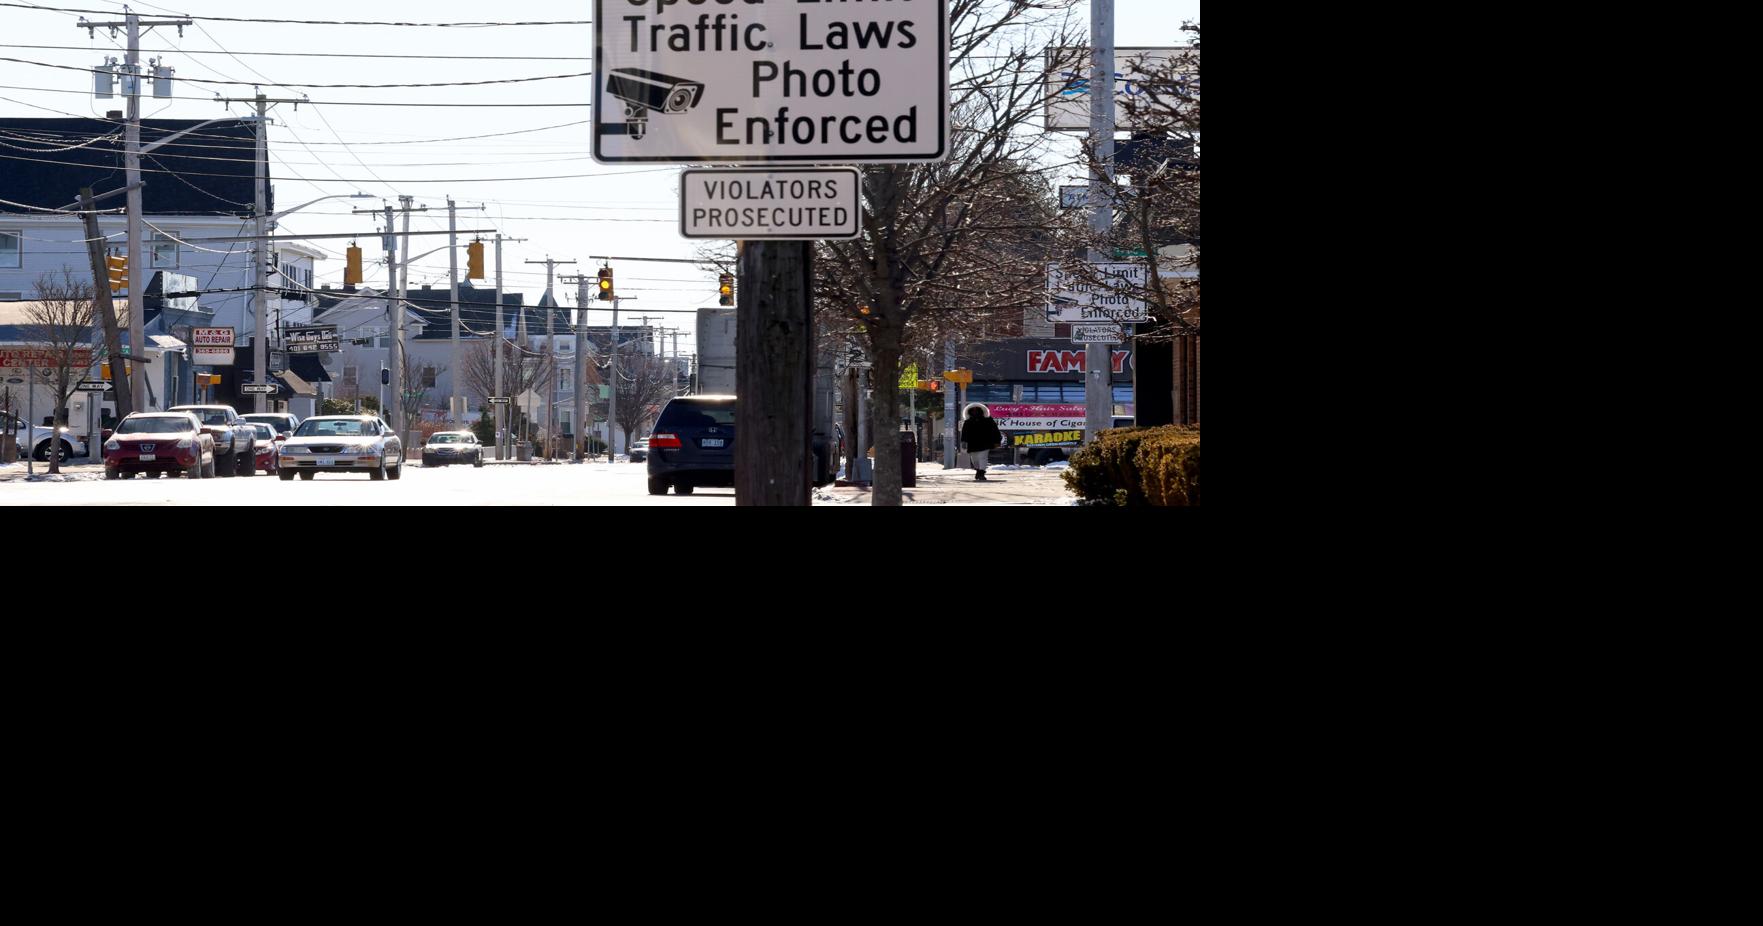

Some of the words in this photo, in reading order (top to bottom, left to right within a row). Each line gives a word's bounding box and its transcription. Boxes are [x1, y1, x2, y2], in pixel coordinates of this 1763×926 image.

[623, 14, 767, 52] Traffic
[800, 13, 917, 50] Laws
[752, 59, 881, 98] Photo
[716, 105, 917, 145] Enforced
[704, 180, 838, 200] VIOLATORS
[693, 207, 848, 227] PROSECUTED
[1092, 294, 1129, 305] Photo
[1027, 350, 1130, 373] FAMY
[1010, 419, 1042, 427] House
[1046, 419, 1057, 428] of
[1013, 430, 1081, 446] KARAOKE
